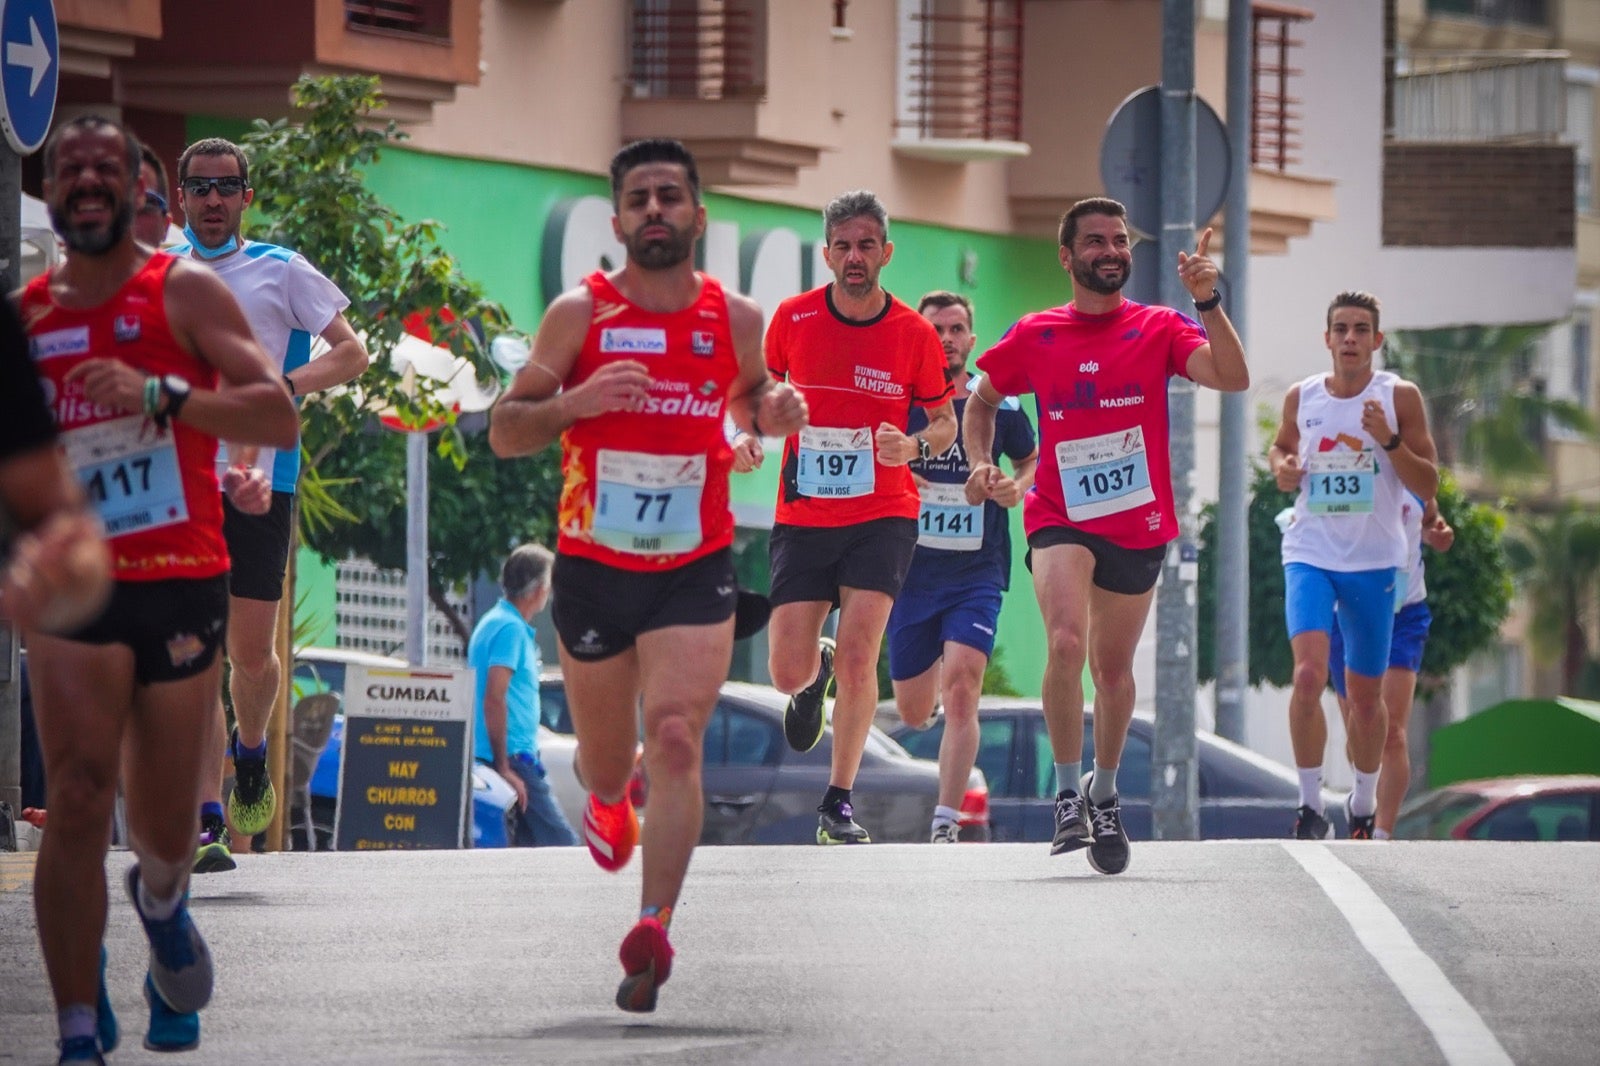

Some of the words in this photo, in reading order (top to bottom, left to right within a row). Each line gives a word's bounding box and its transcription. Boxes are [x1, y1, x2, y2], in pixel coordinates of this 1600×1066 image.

[854, 365, 891, 381] RUNNING
[1079, 360, 1099, 375] edp
[1099, 395, 1145, 408] MADRID!
[816, 454, 858, 476] 197
[1078, 463, 1135, 497] 1037
[1322, 476, 1360, 495] 133
[817, 486, 834, 495] JUAN
[834, 486, 850, 496] JOSÉ
[634, 492, 673, 522] 77
[920, 510, 972, 533] 1141
[633, 536, 662, 550] DAVID
[366, 684, 451, 704] CUMBAL
[388, 760, 420, 779] HAY
[366, 786, 438, 806] CHURROS
[384, 814, 416, 831] CON
